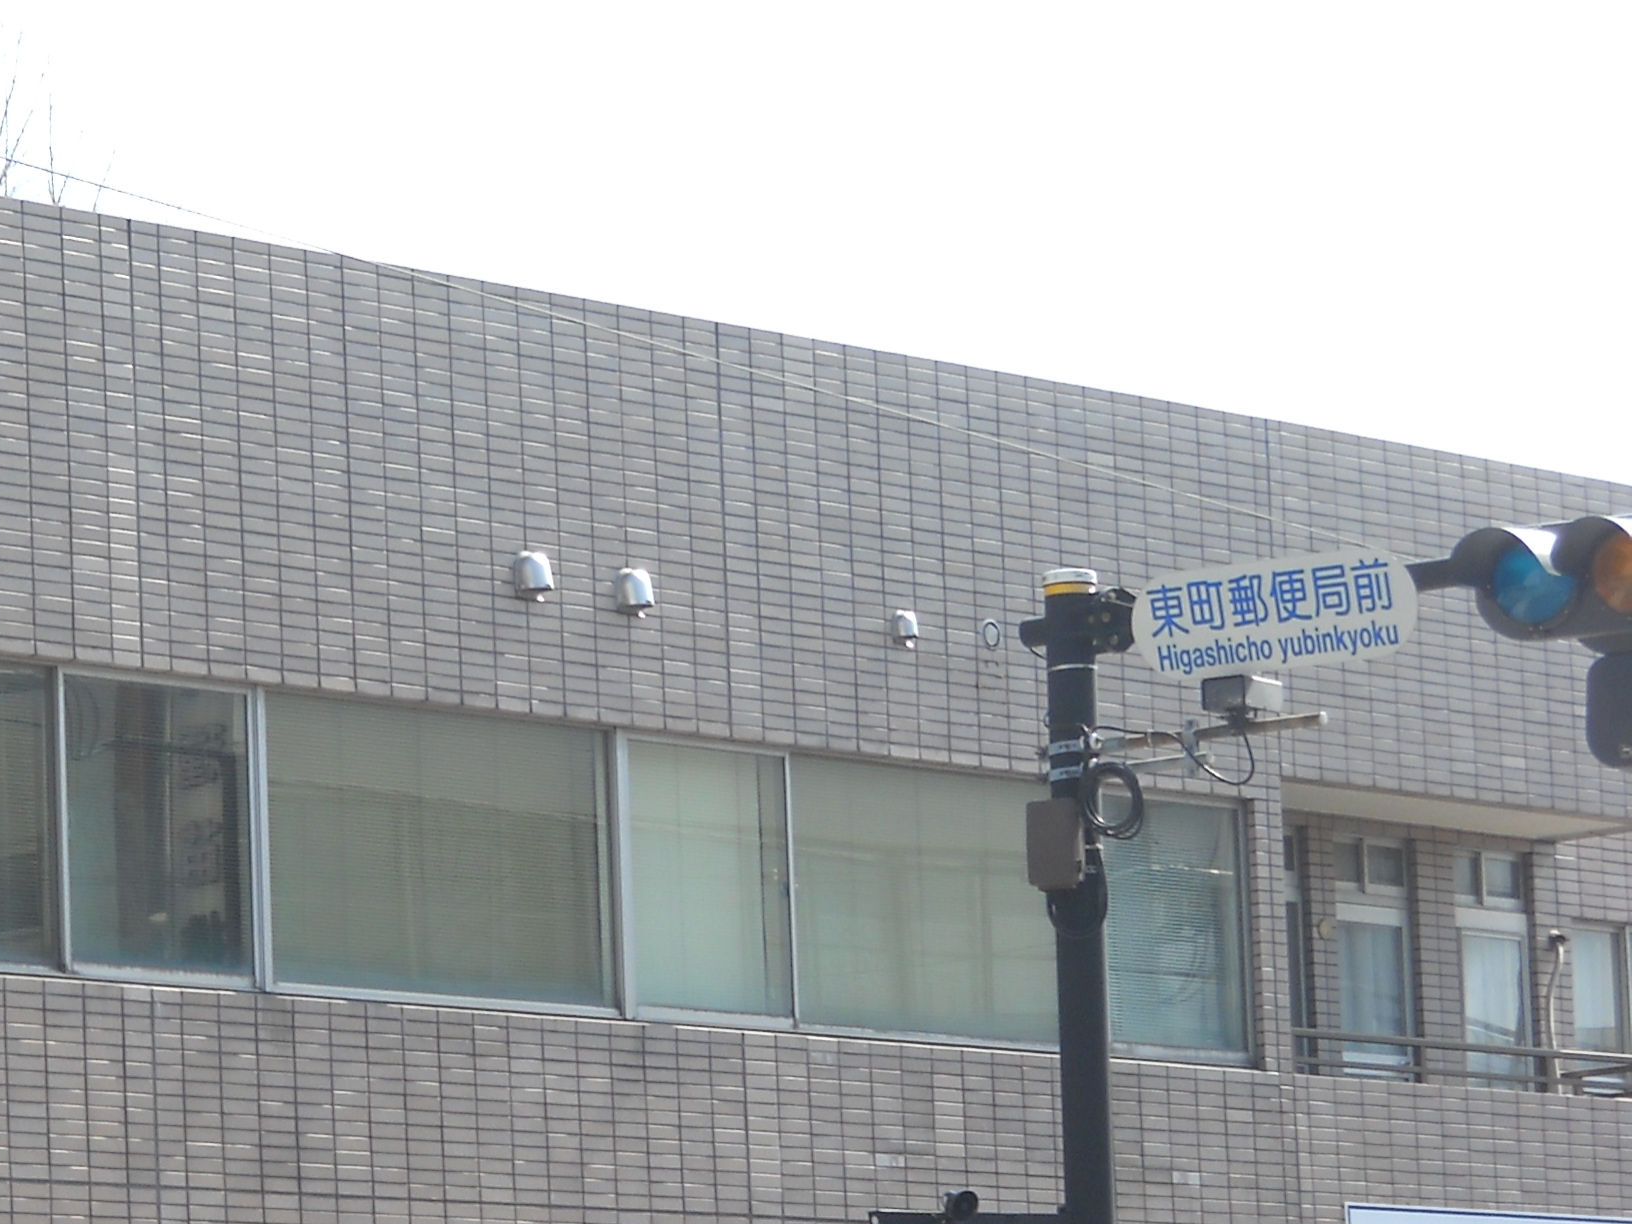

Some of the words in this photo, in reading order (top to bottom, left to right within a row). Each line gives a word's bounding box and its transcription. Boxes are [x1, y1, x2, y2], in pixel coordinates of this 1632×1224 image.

[1146, 558, 1393, 638] 東町郵便局前
[1157, 635, 1273, 676] Higashicho
[1278, 620, 1400, 664] yubinkyoku
